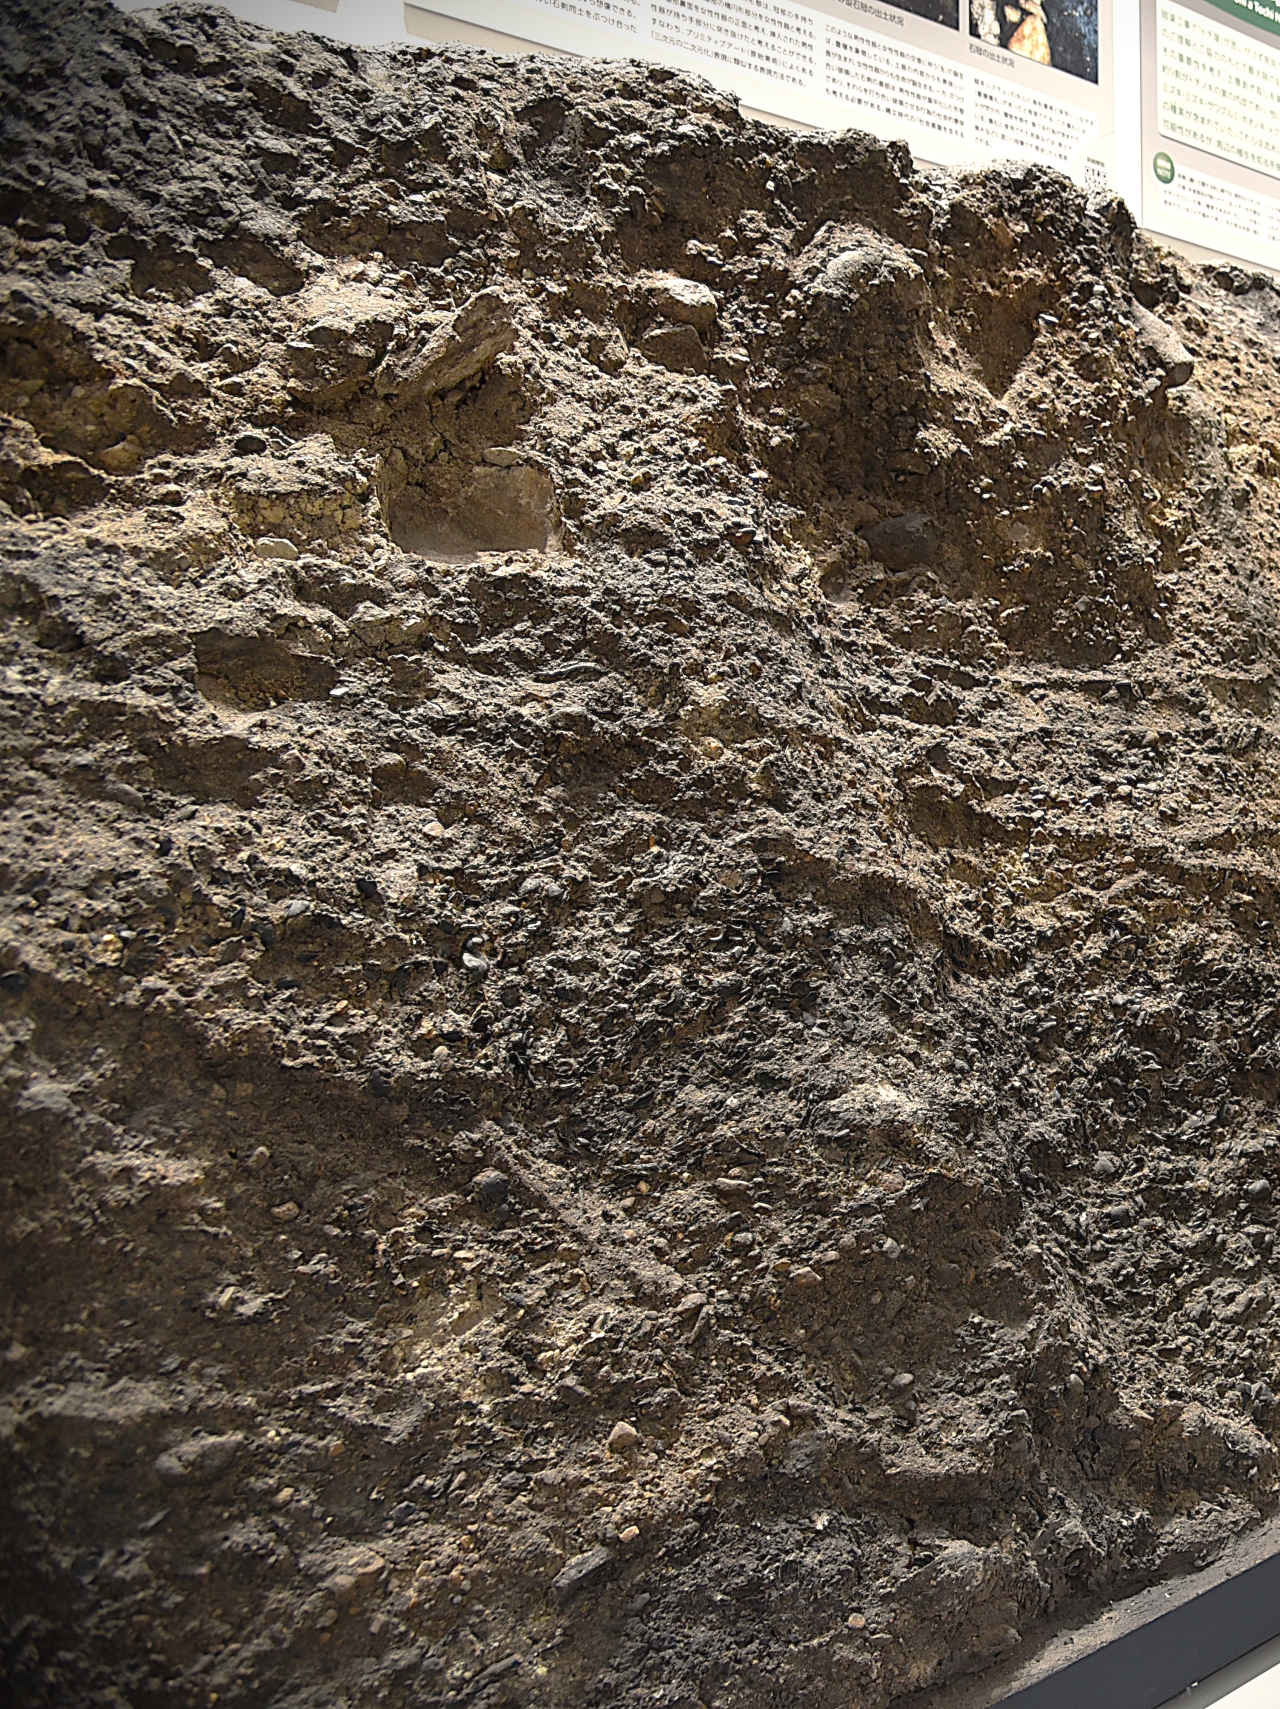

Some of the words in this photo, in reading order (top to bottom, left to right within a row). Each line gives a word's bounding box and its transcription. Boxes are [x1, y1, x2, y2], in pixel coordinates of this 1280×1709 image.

[536, 0, 637, 33] 石剣同士をぶつけ合った
[705, 0, 817, 40] 部の楕円形部分を女性性器と考える。
[838, 0, 904, 27] 型石冠の出土状況
